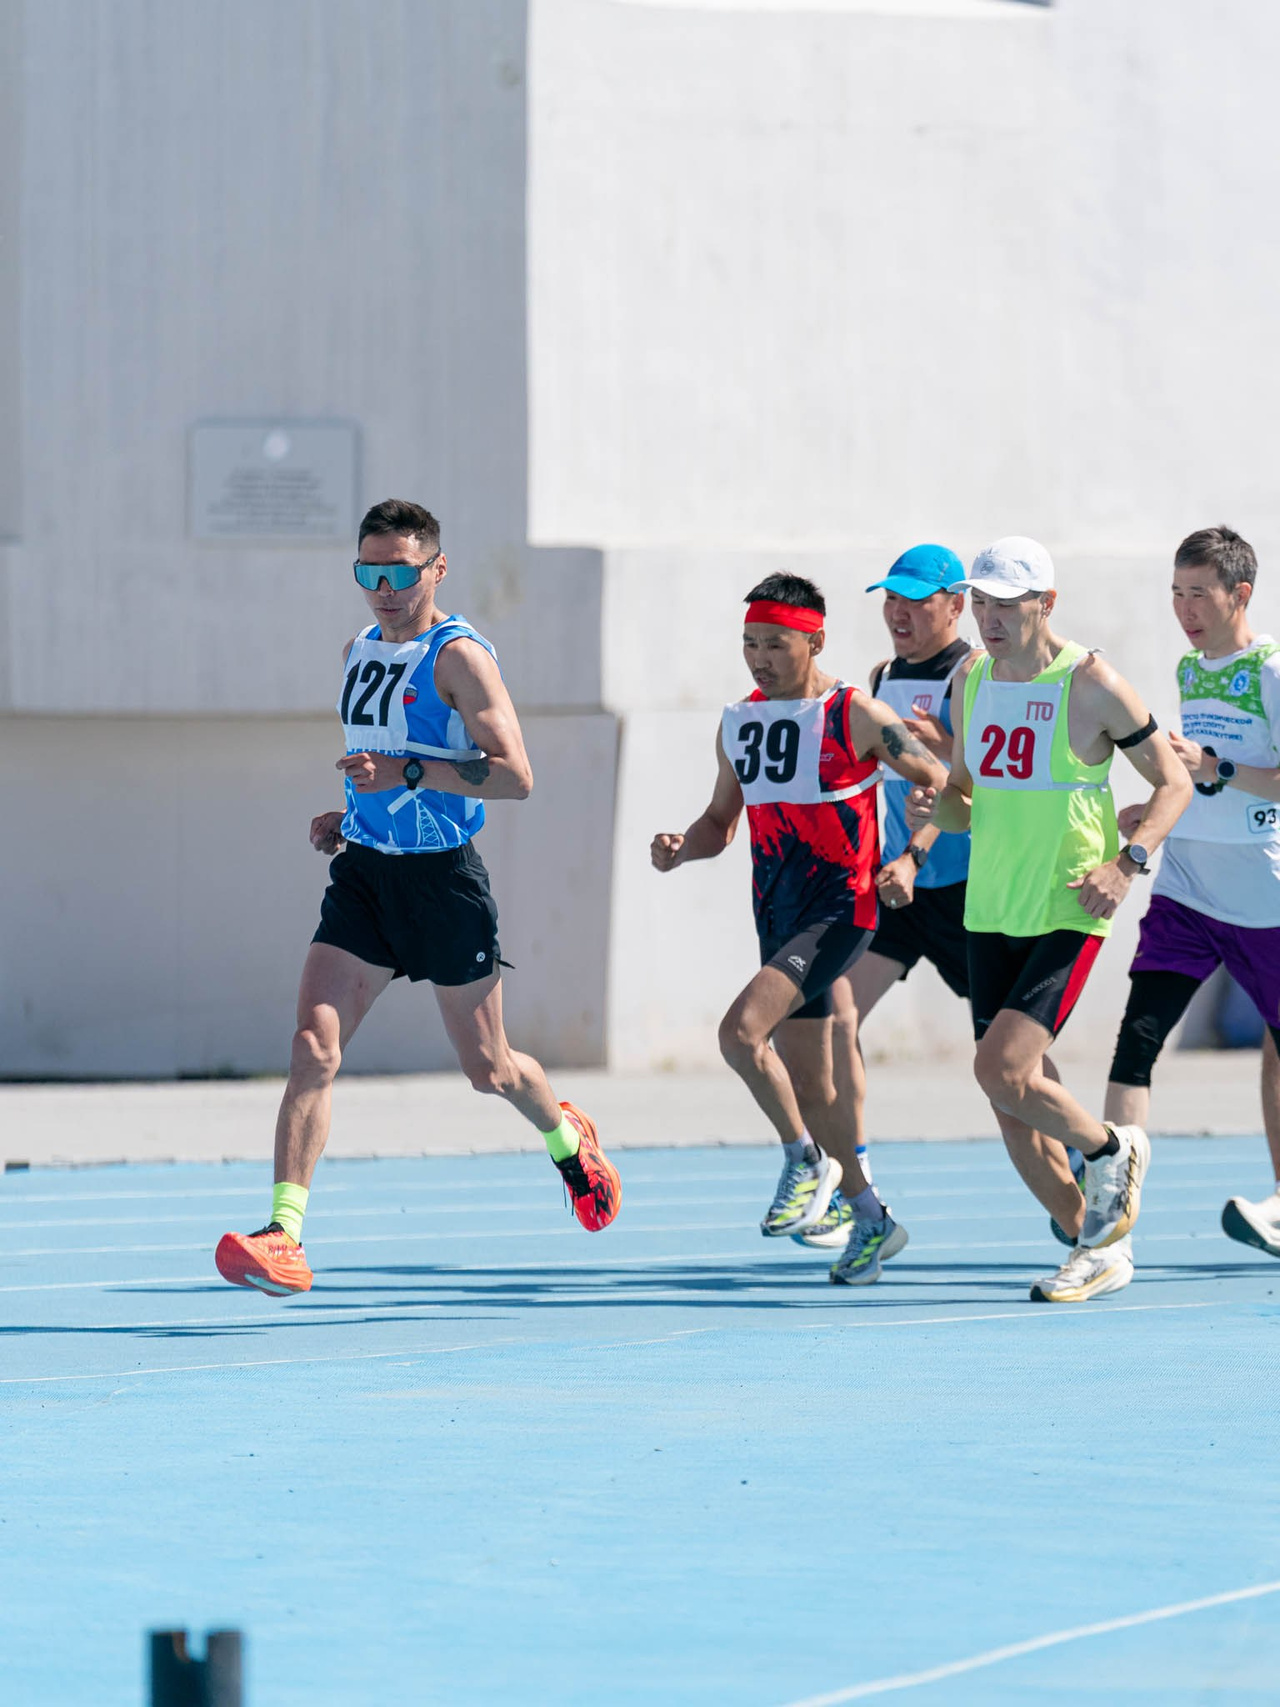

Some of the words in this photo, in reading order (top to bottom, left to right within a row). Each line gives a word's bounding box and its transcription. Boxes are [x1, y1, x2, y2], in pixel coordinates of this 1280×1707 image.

[341, 659, 408, 728] 127
[735, 719, 800, 785] 39
[979, 724, 1036, 780] 29
[1254, 808, 1278, 828] 93
